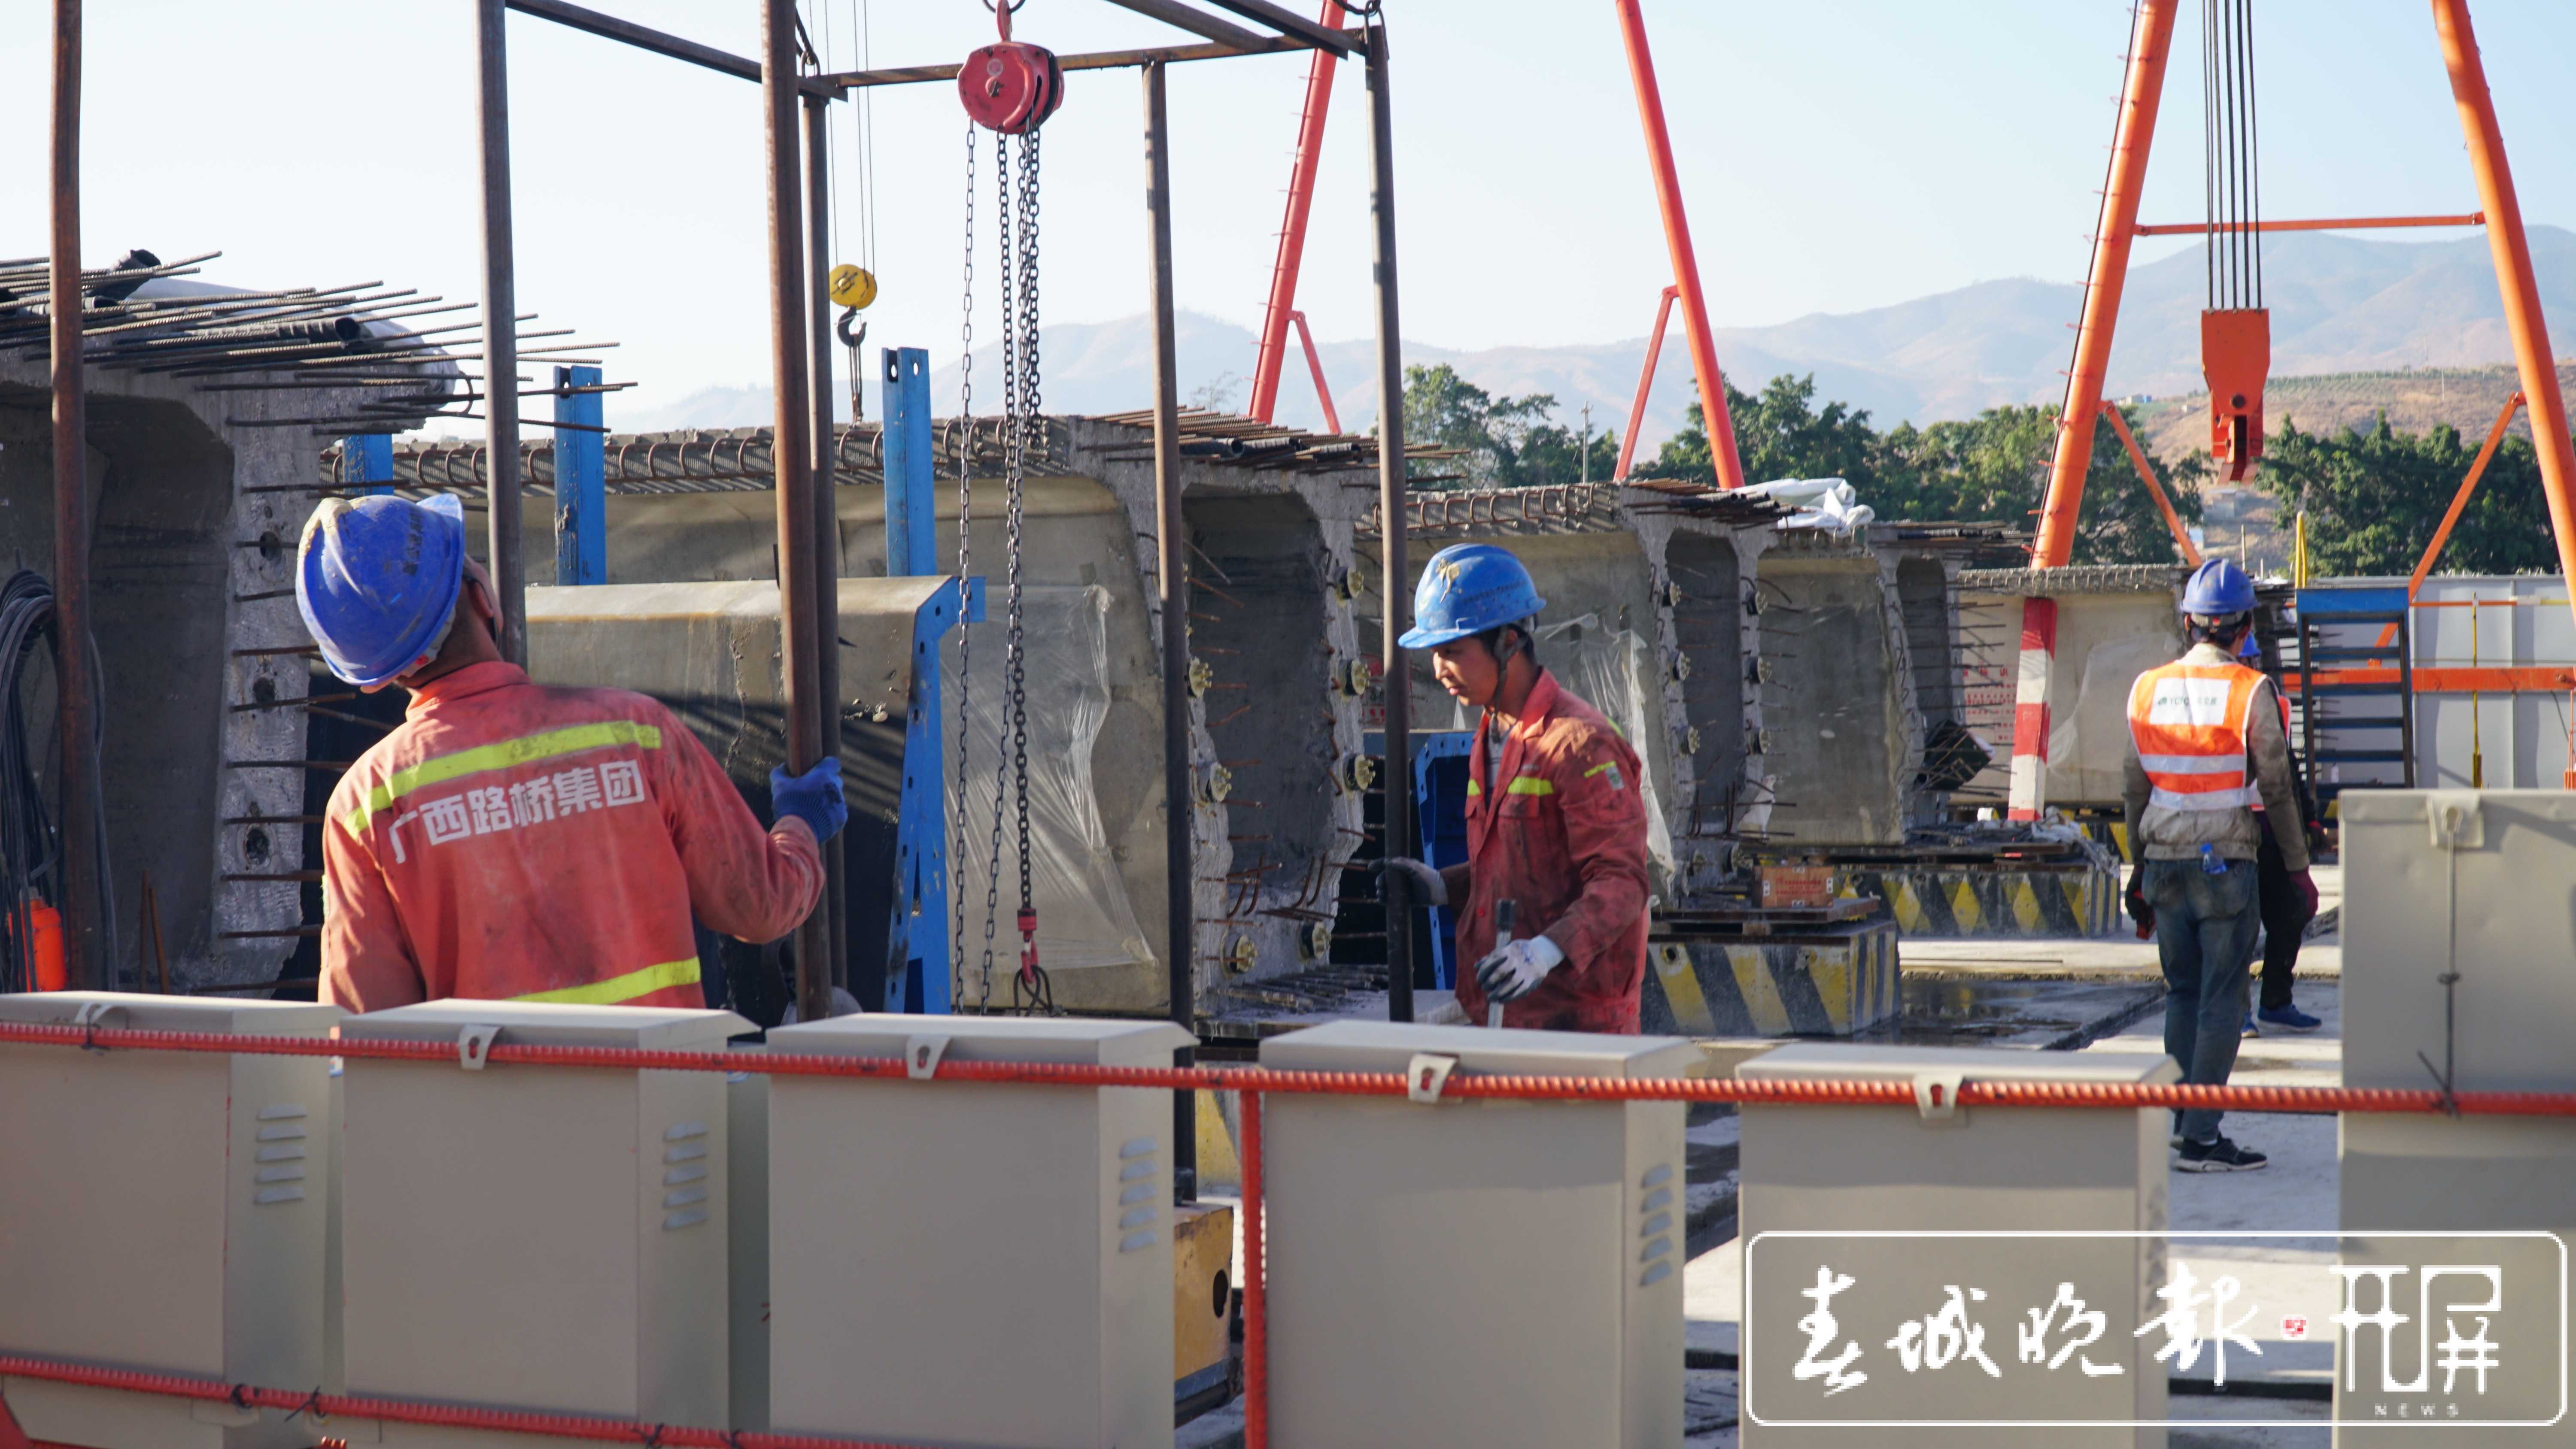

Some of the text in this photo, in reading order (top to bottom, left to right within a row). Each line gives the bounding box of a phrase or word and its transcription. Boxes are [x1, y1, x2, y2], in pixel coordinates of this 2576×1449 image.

[388, 759, 645, 864] 广西路桥集团
